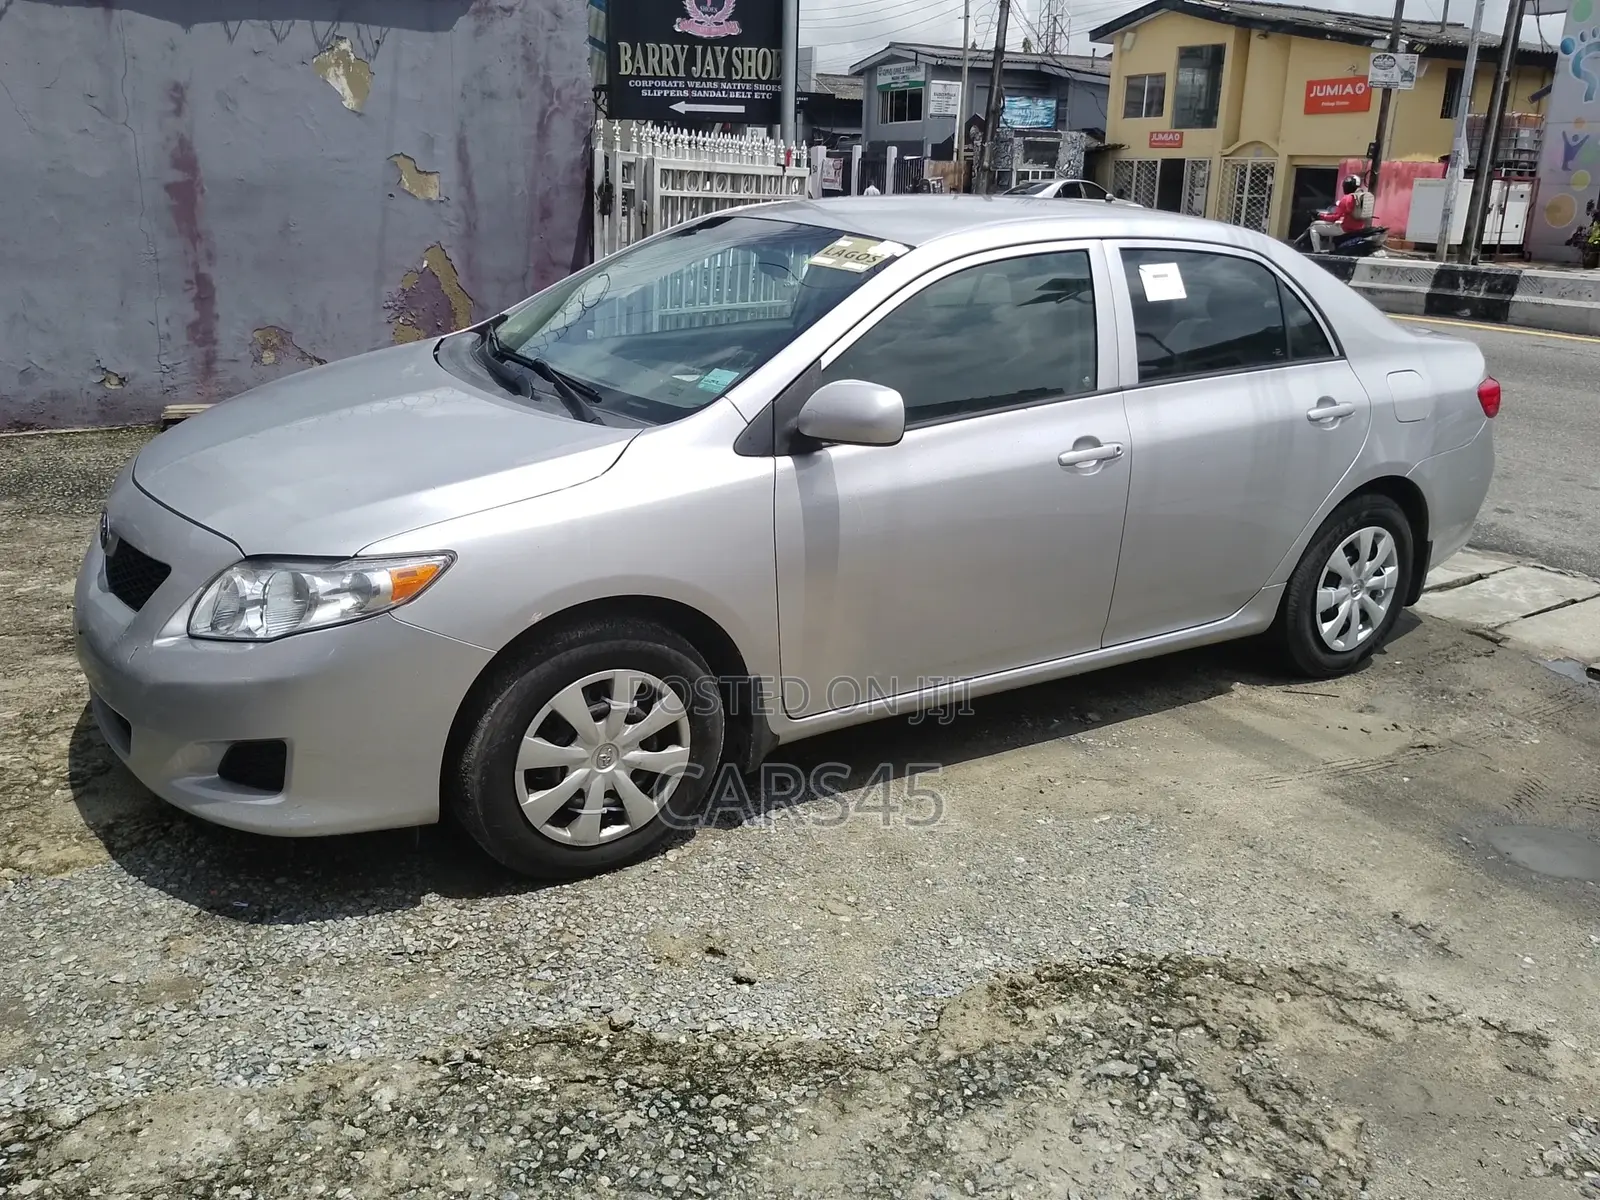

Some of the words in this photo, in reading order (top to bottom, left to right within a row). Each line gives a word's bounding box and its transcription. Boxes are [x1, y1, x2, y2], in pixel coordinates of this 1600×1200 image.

[618, 41, 689, 77] BARRY
[691, 45, 729, 78] JAY
[732, 46, 782, 80] SHOE
[628, 80, 685, 88] CORPORATE
[687, 81, 718, 89] WEARS
[720, 82, 752, 90] NATIVE
[753, 84, 782, 92] SHOES
[641, 89, 689, 97] SLIPPERS
[691, 90, 728, 98] SANDAL
[754, 92, 773, 100] ETC
[823, 247, 881, 264] LAGOS
